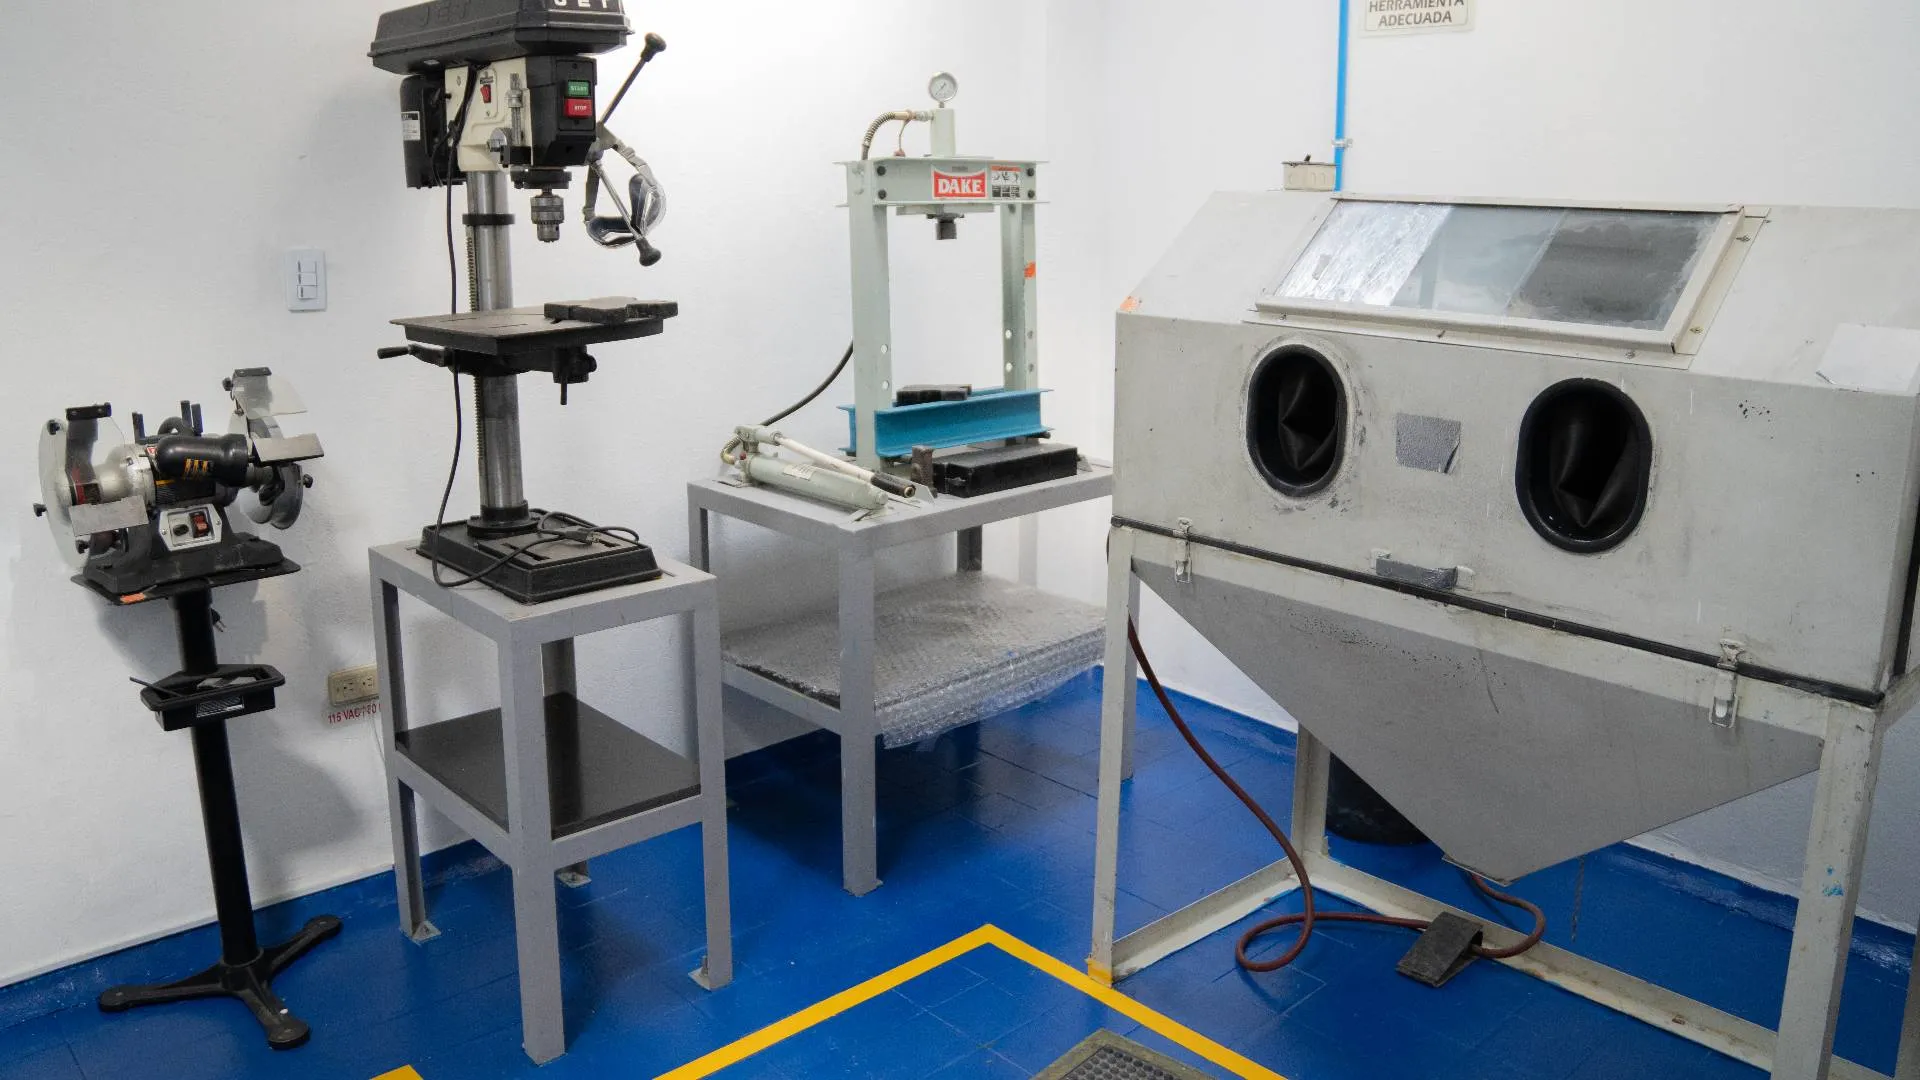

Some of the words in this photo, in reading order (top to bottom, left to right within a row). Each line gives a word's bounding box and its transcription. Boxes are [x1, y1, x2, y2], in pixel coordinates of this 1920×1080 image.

[1379, 11, 1452, 26] ADECUADA
[938, 178, 983, 193] DAKE
[343, 708, 361, 721] VAC
